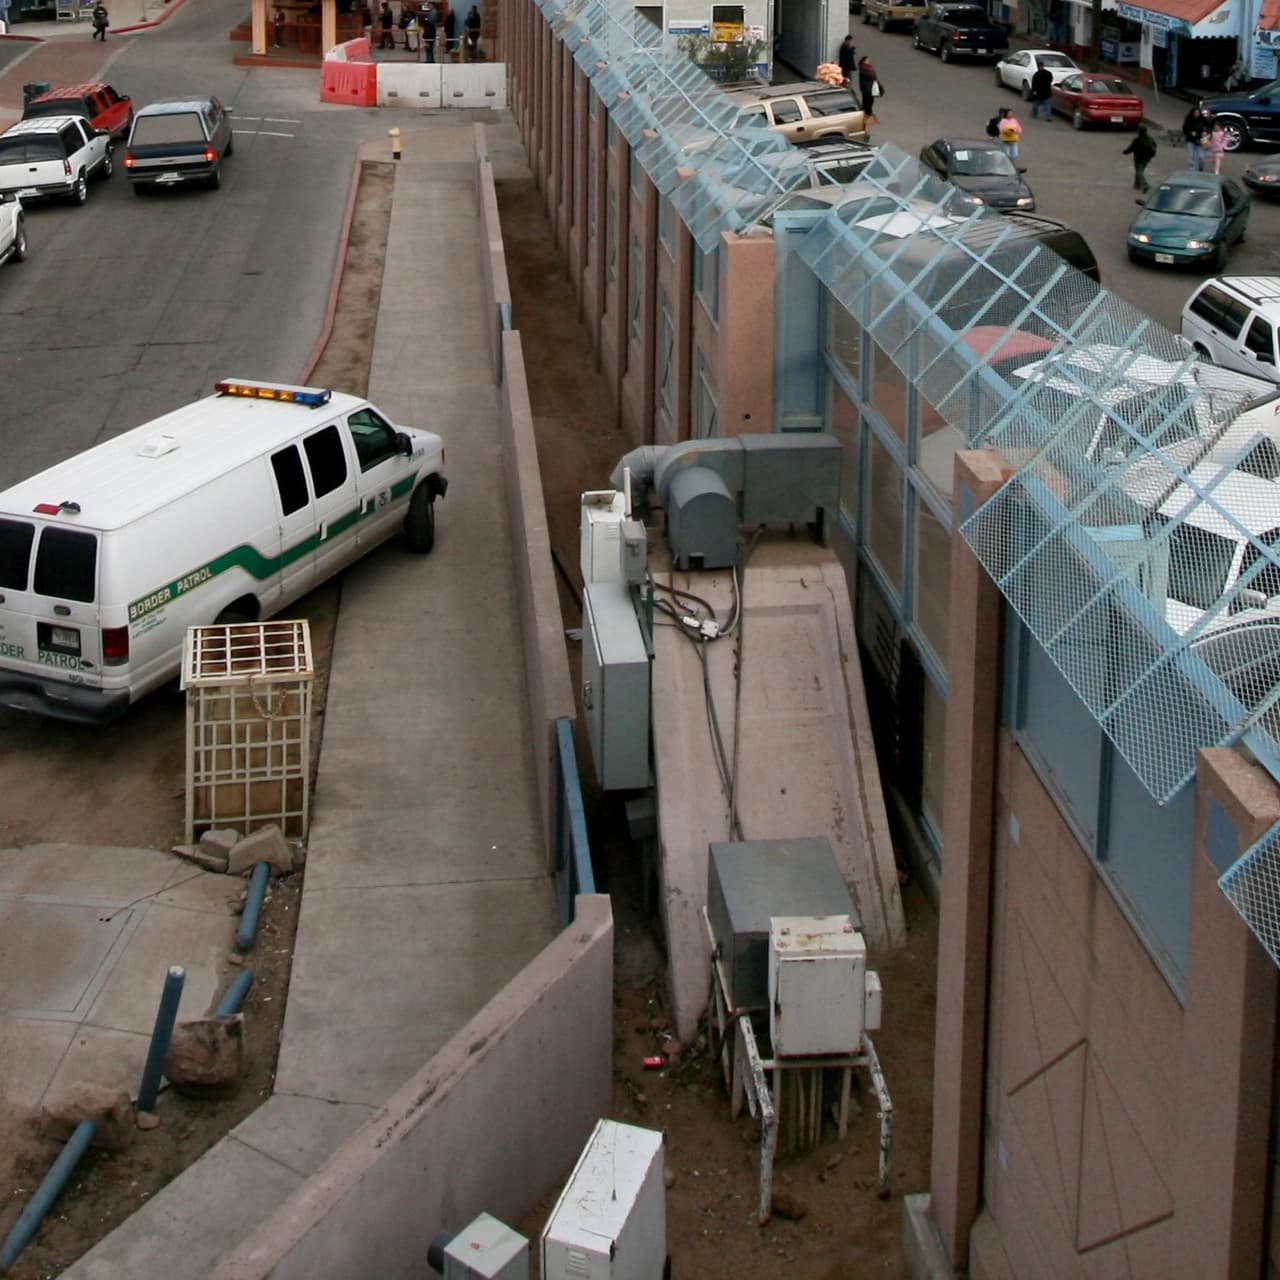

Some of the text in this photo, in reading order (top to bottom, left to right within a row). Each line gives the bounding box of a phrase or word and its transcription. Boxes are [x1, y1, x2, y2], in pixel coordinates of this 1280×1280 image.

[130, 566, 212, 619] BORDER PATROL
[38, 650, 85, 671] PATROL
